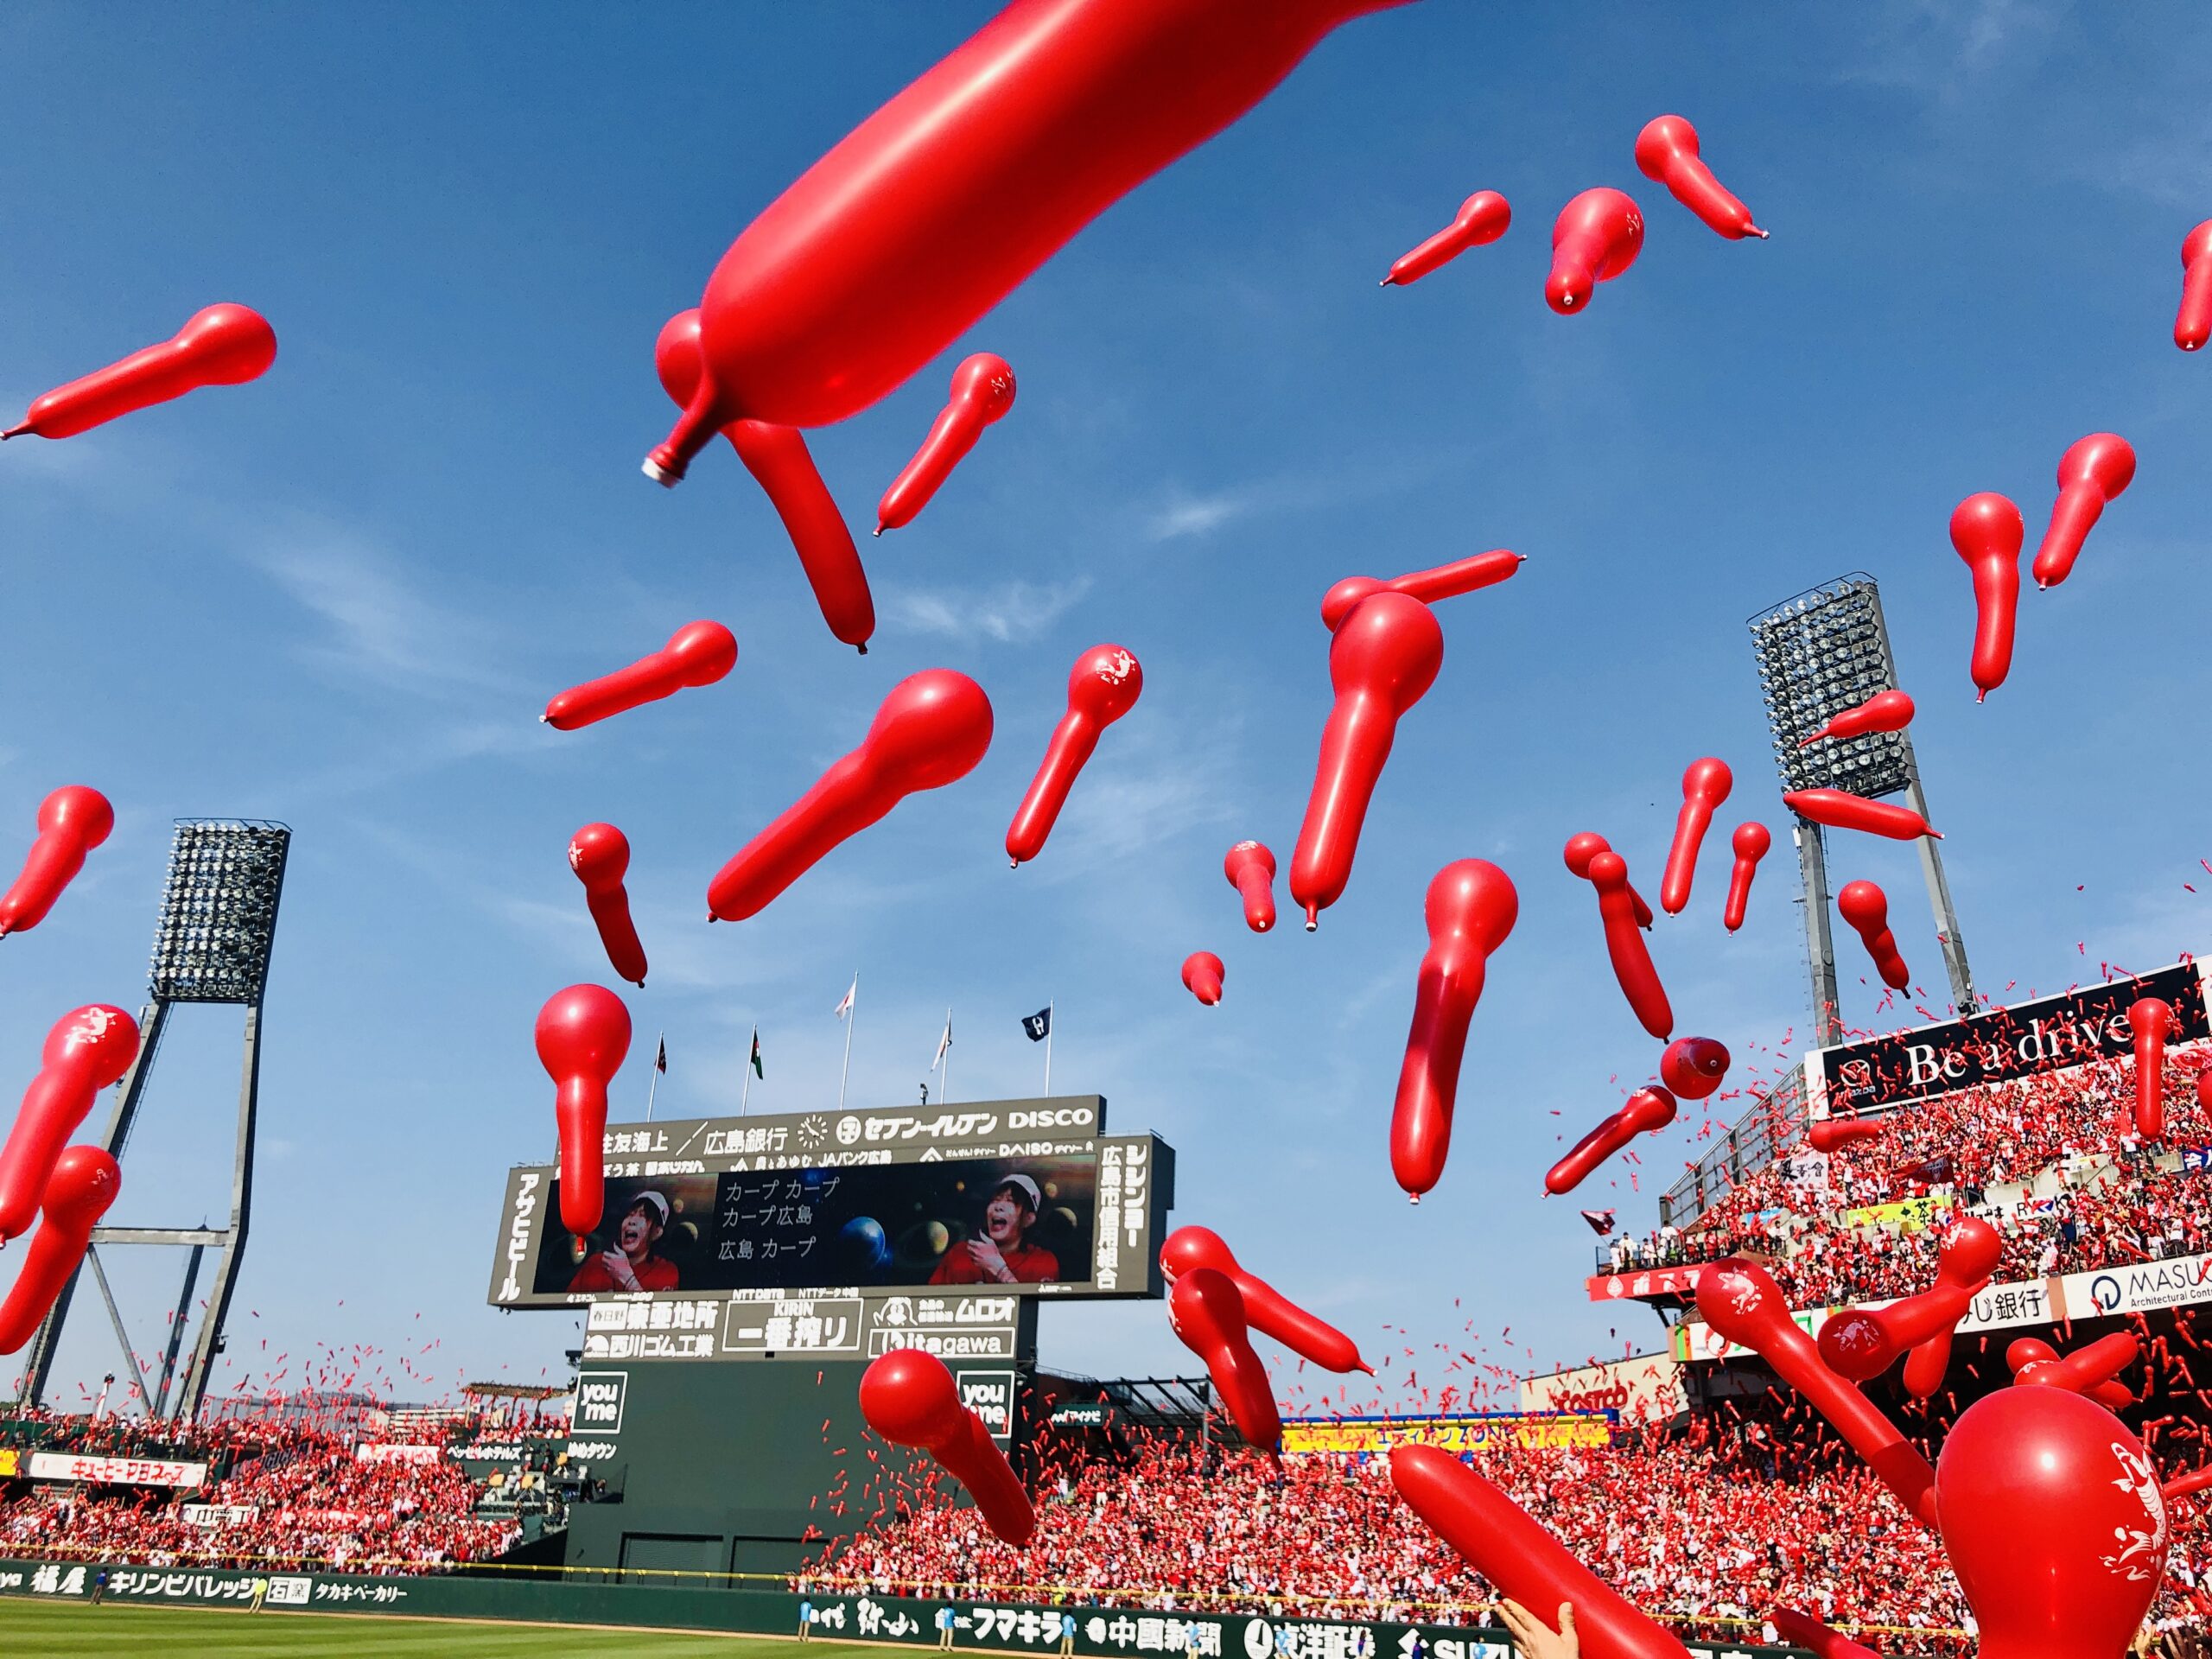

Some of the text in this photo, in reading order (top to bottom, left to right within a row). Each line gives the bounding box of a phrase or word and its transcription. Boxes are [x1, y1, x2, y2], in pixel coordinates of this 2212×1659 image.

[1903, 1011, 2132, 1086] Be a drive
[1008, 1108, 1094, 1128] DISCO
[703, 1127, 789, 1155] 広島銀行
[999, 1141, 1053, 1157] DAISO
[726, 1176, 841, 1203] カープ カープ
[722, 1204, 814, 1229] カープ広島
[1096, 1145, 1123, 1290] 広島市信用組合
[498, 1173, 540, 1302] アサヒビール
[718, 1236, 817, 1261] 広島 カープ
[773, 1302, 814, 1317] KIRIN
[955, 1297, 1015, 1323] ムロオ
[2131, 1288, 2212, 1307] Architectural Cont
[626, 1300, 719, 1331] 東亜地所
[737, 1316, 848, 1349] 一番搾り
[610, 1333, 715, 1358] 西川ゴム工業
[580, 1383, 619, 1407] you
[962, 1383, 1006, 1403] you
[585, 1402, 618, 1421] me
[567, 1440, 618, 1460] ゆめタウン
[29, 1564, 87, 1594] 福屋
[107, 1571, 259, 1599] キリンビバレッジ
[315, 1582, 408, 1604] タカキベーカリー
[972, 1607, 1077, 1645] フマキラ
